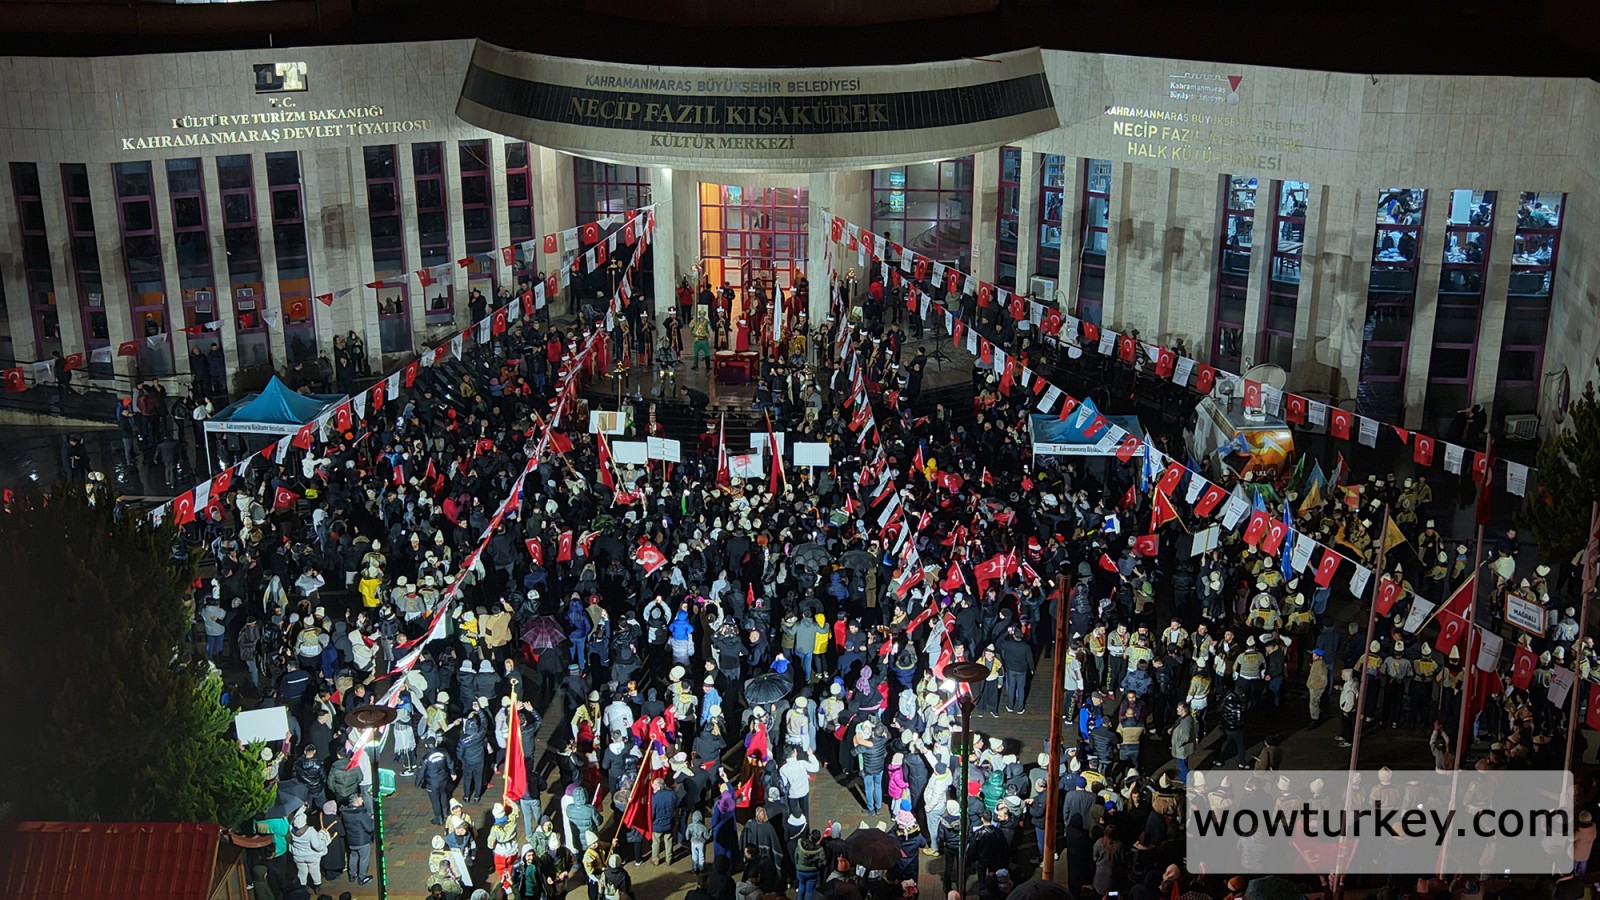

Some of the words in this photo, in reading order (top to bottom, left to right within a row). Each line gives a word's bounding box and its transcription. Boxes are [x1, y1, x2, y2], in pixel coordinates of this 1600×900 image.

[585, 75, 692, 93] KAHRAMANMARAŞ
[697, 78, 781, 94] BÜYÜKŞEHİR
[788, 77, 861, 93] BELEDİYESİ
[269, 97, 296, 108] T.C.
[568, 96, 641, 121] NECİP
[644, 103, 721, 125] FAZIL
[725, 101, 889, 126] KISAKÜREK
[172, 114, 229, 129] KÜLTÜR
[230, 114, 250, 126] VE
[251, 110, 306, 124] TURİZM
[309, 104, 384, 121] BAKANLIĞI
[121, 128, 280, 150] KAHRAMANMARAŞ
[283, 125, 343, 140] DEVLET
[346, 119, 433, 136] TİYATROSU
[650, 133, 716, 150] KÜLTÜR
[719, 135, 795, 150] MERKEZİ
[1113, 121, 1158, 138] NECİP
[1162, 127, 1204, 142] FAZIL
[1128, 141, 1168, 160] HALK
